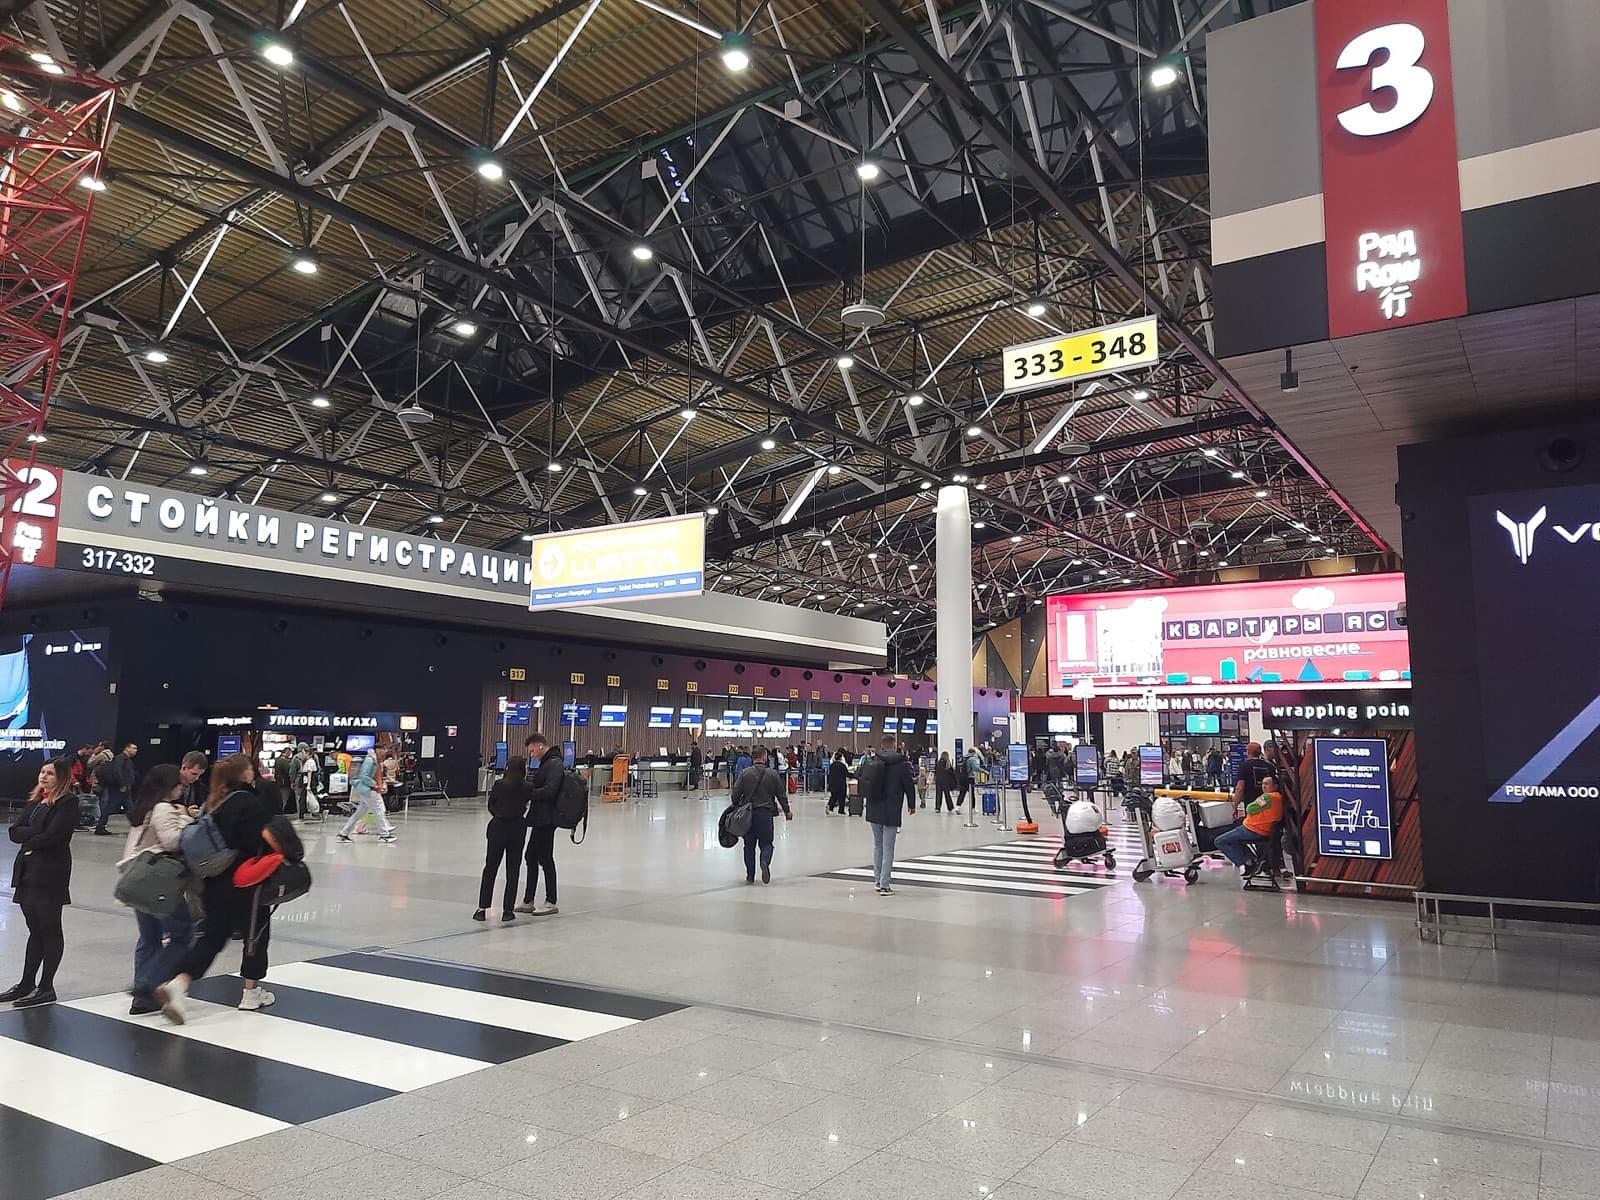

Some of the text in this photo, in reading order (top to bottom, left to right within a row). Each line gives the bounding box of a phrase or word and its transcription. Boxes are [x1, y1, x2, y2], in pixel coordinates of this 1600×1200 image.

[1336, 23, 1434, 136] 3
[1358, 229, 1417, 261] Ряд
[1356, 258, 1420, 291] Row
[1379, 285, 1412, 320] 行
[1014, 349, 1064, 380] 333
[1091, 332, 1147, 364] 348
[12, 467, 57, 517] 2
[87, 485, 280, 545] СТОЙКИ
[82, 548, 154, 575] 317-332
[1168, 614, 1321, 639] КВАРТИРЫ
[1243, 641, 1361, 664] равновесие
[511, 669, 525, 680] 317
[572, 674, 584, 683] 318
[608, 676, 620, 686] 319
[1108, 697, 1262, 711] ВЫХОДЫ НА ПОСАДКУ
[1271, 703, 1358, 720] wrapping
[270, 715, 377, 728] УПАКОВКА БАГАЖА
[1506, 785, 1599, 798] РЕКЛАМА ООО
